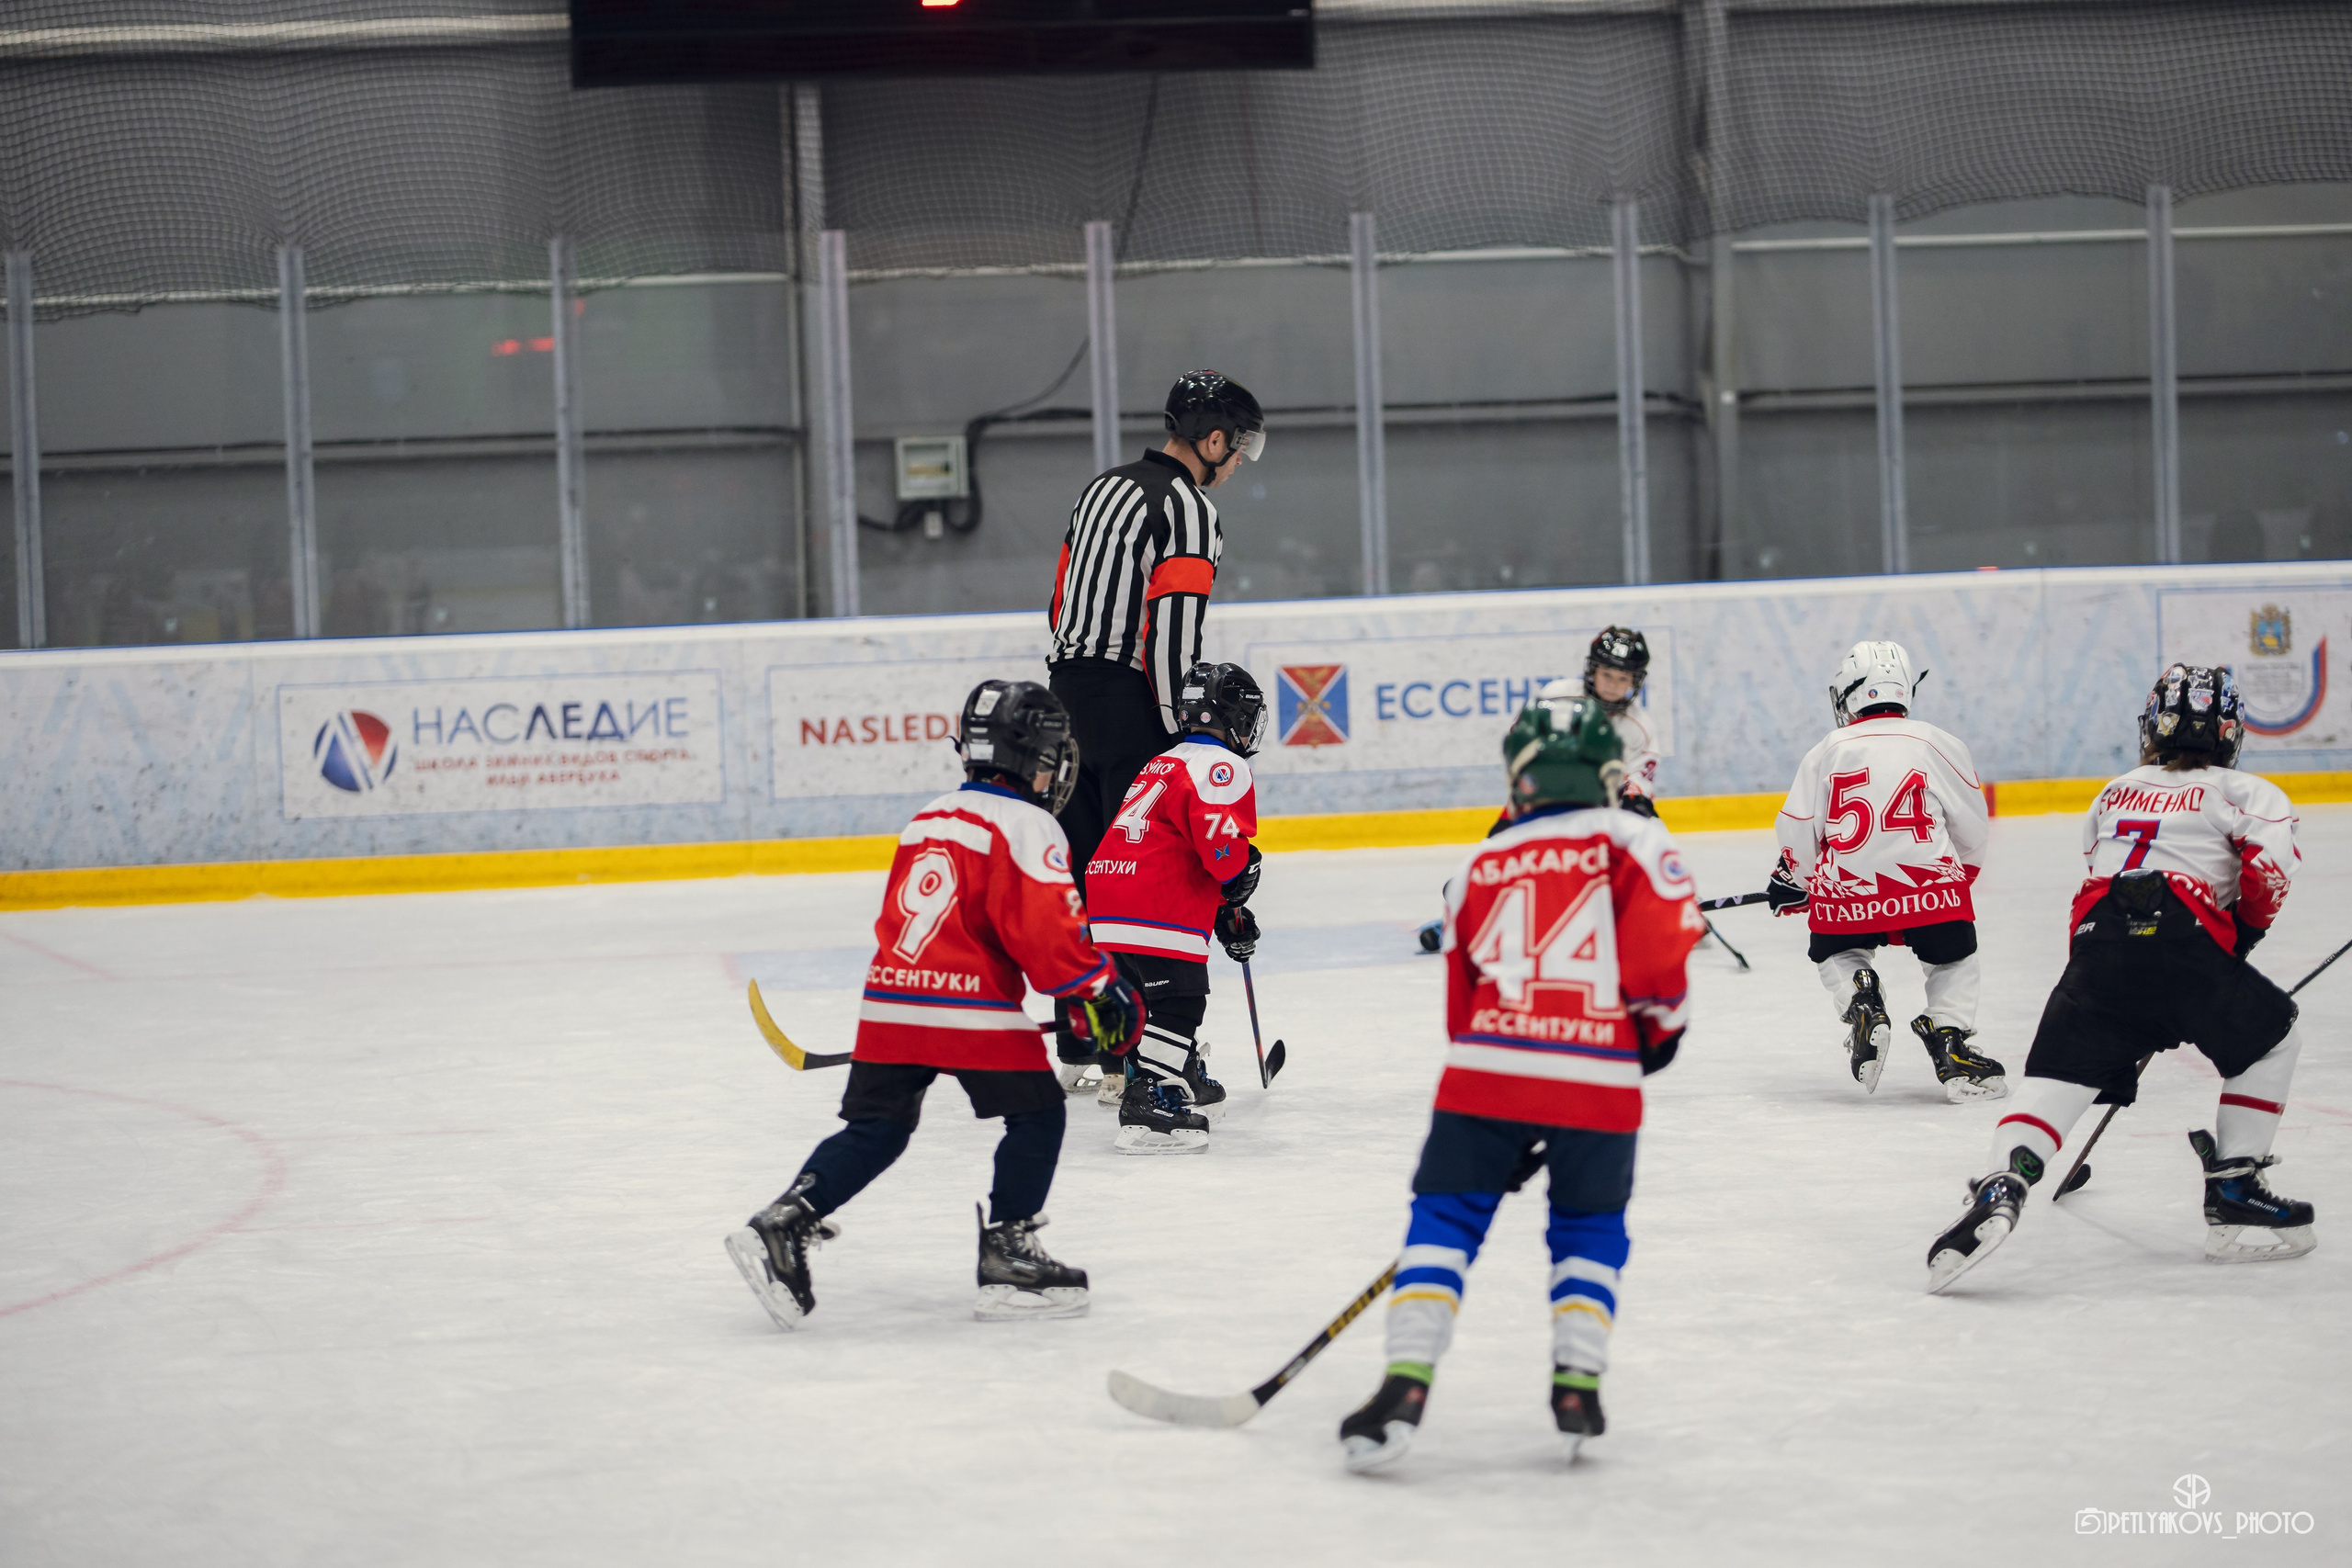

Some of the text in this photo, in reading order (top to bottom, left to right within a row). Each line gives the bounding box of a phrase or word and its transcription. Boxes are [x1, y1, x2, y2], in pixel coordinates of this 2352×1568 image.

[1376, 673, 1647, 721] ЕССЕН
[413, 697, 690, 745] НАСЛЕДИЕ
[800, 713, 961, 745] NASLEDI
[1204, 813, 1239, 840] 74
[1825, 767, 1937, 855] 54
[2112, 819, 2161, 872] 7
[1085, 860, 1136, 874] СЕНТУКИ
[891, 847, 958, 964] 9
[1065, 887, 1082, 917] 9
[1815, 888, 1961, 922] СТАВРОПОЛЬ
[1467, 877, 1626, 1020] 44
[2247, 1198, 2278, 1213] BAUER
